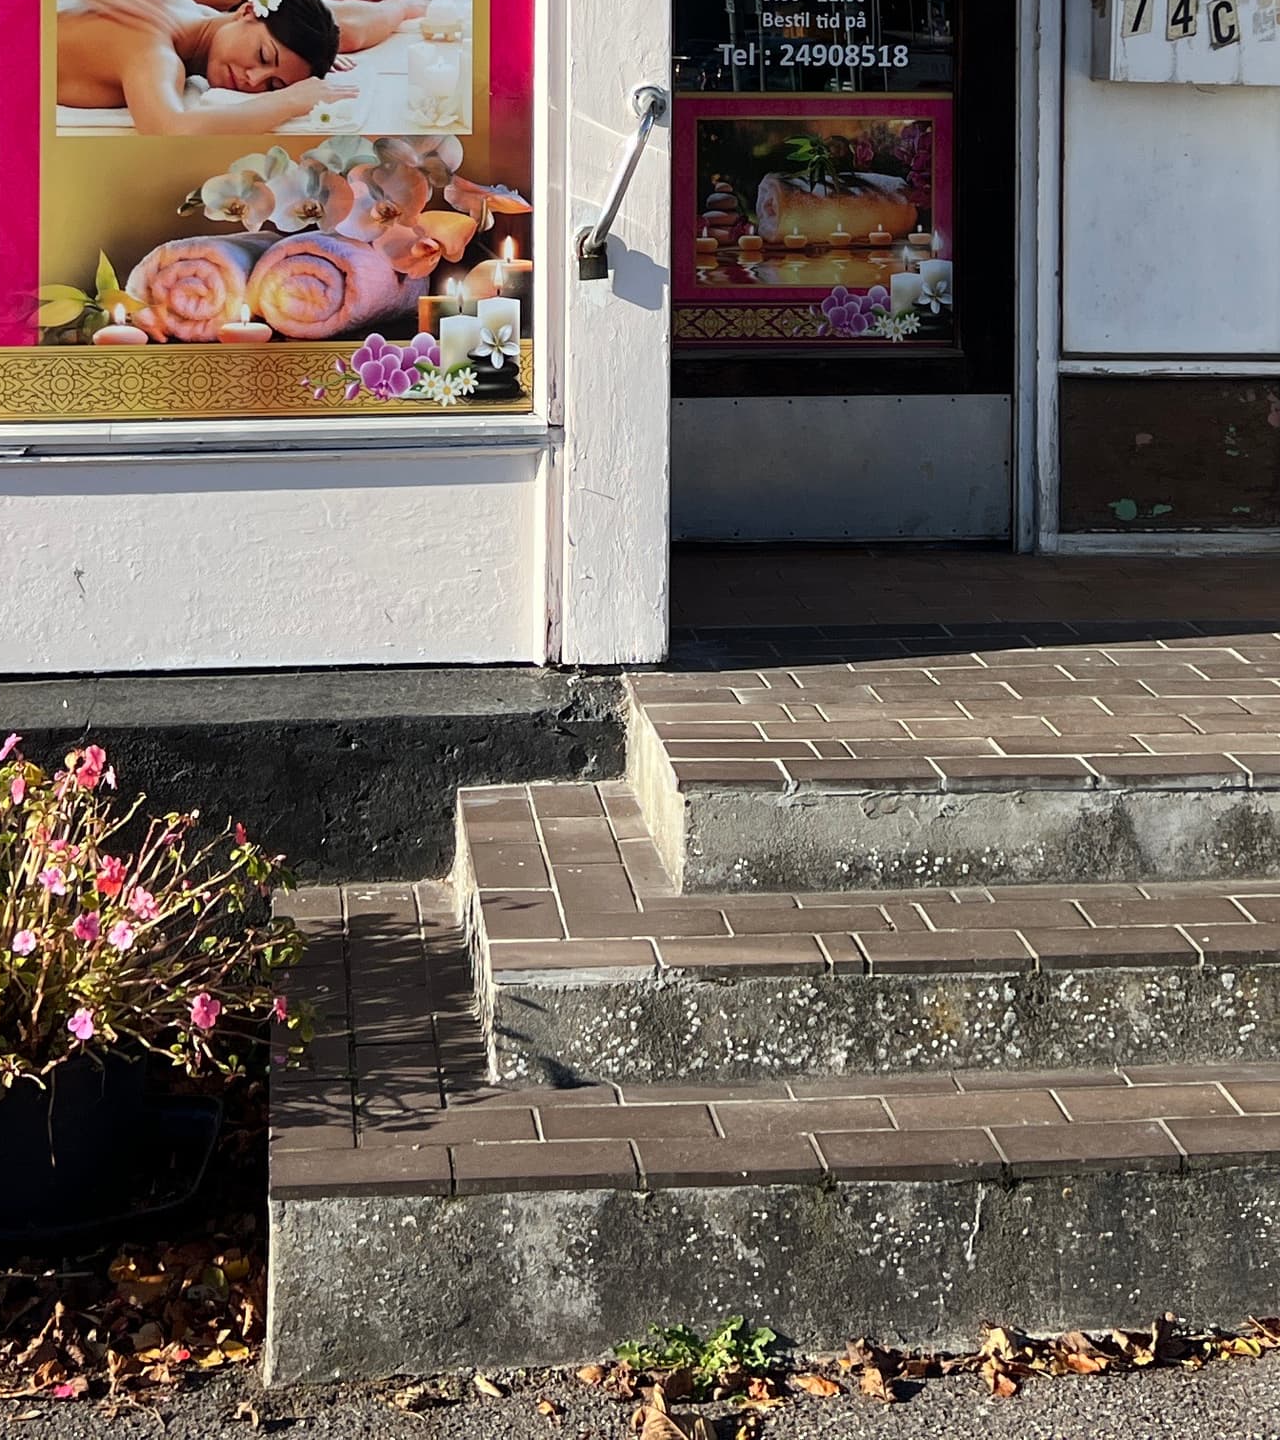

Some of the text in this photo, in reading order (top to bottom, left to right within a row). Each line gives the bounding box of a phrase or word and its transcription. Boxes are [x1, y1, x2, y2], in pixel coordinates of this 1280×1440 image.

[762, 11, 867, 30] Bestil tid på
[719, 43, 756, 66] Tel
[779, 44, 909, 68] 24908518
